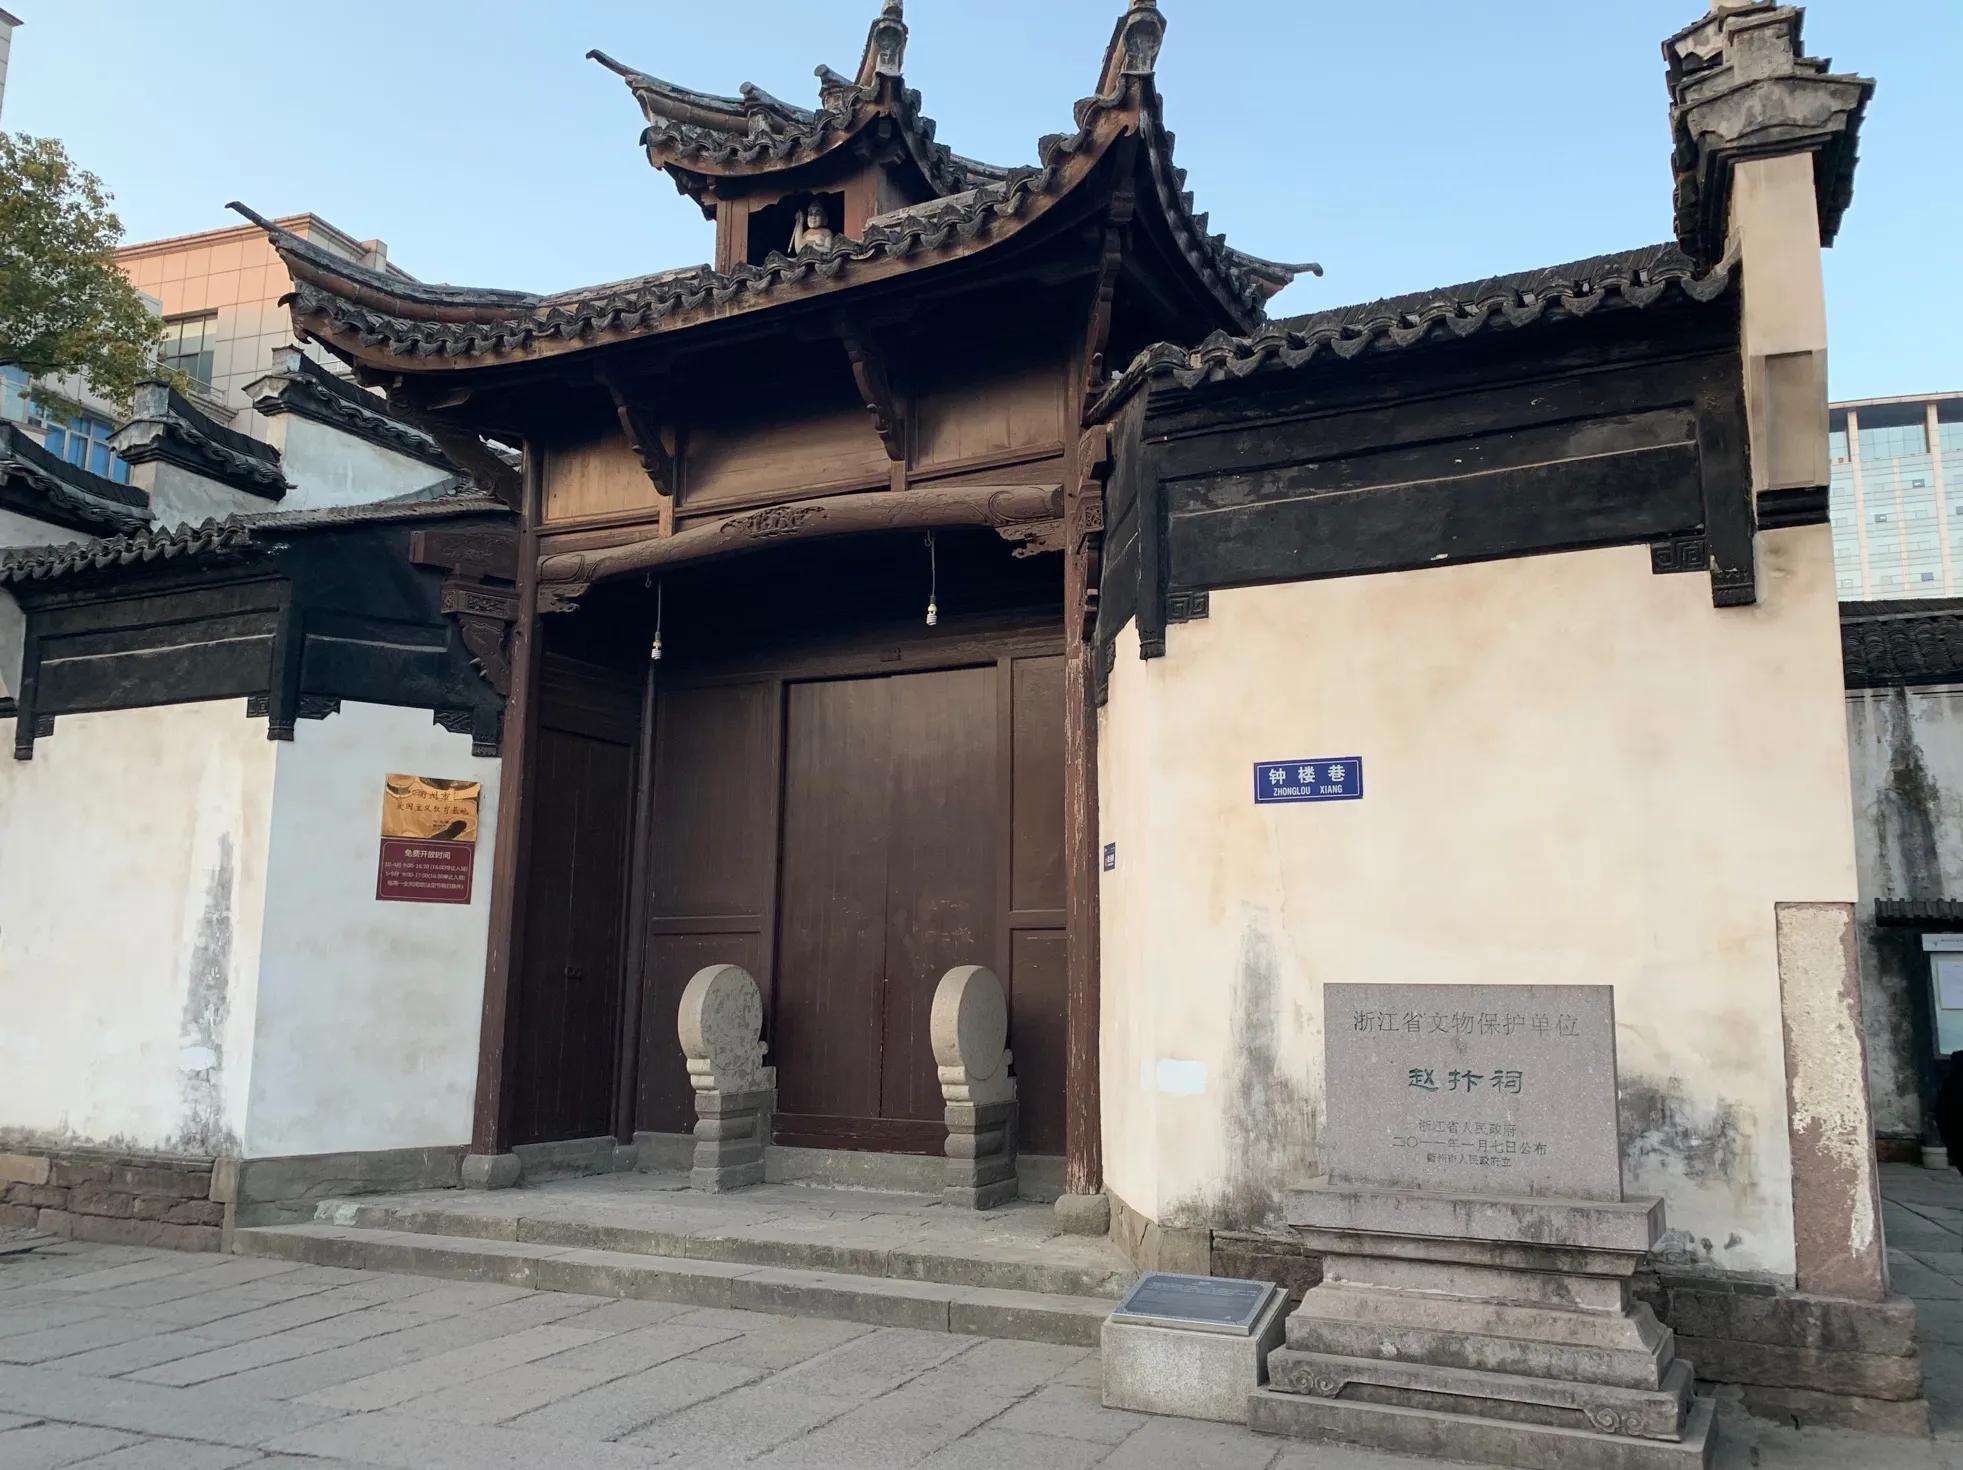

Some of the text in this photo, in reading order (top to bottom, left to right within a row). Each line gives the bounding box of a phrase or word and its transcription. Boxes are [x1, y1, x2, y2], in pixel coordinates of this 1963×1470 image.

[1269, 765, 1345, 785] 钟楼巷
[1273, 785, 1343, 796] ZHONGLOU XIANG
[404, 849, 451, 860] 免费开放时间
[1354, 1010, 1580, 1037] 浙江省文物保护单位
[1408, 1067, 1523, 1094] 赵抃祠
[1418, 1120, 1517, 1136] 浙江省人民政府
